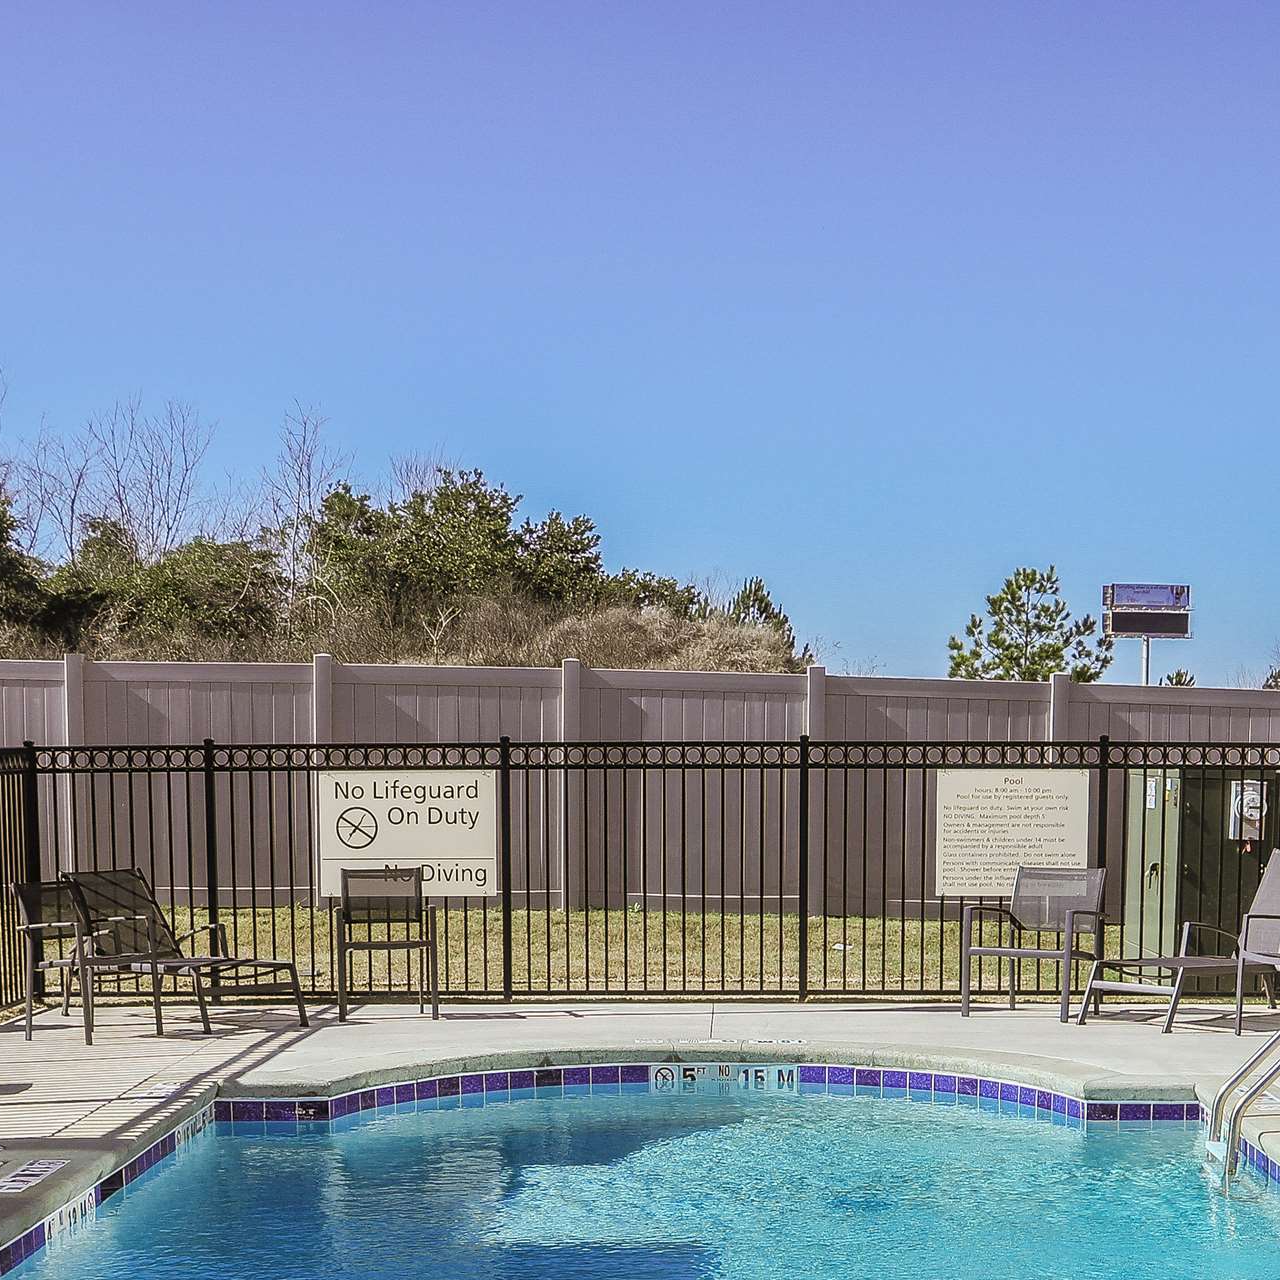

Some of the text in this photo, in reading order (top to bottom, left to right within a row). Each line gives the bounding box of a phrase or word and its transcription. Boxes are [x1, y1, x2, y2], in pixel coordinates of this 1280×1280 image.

[1004, 777, 1023, 785] Pool
[335, 779, 479, 804] No Lifeguard
[388, 807, 480, 829] On Duty
[421, 863, 487, 887] Diving
[683, 1067, 706, 1081] 5 FT
[719, 1065, 730, 1077] NO
